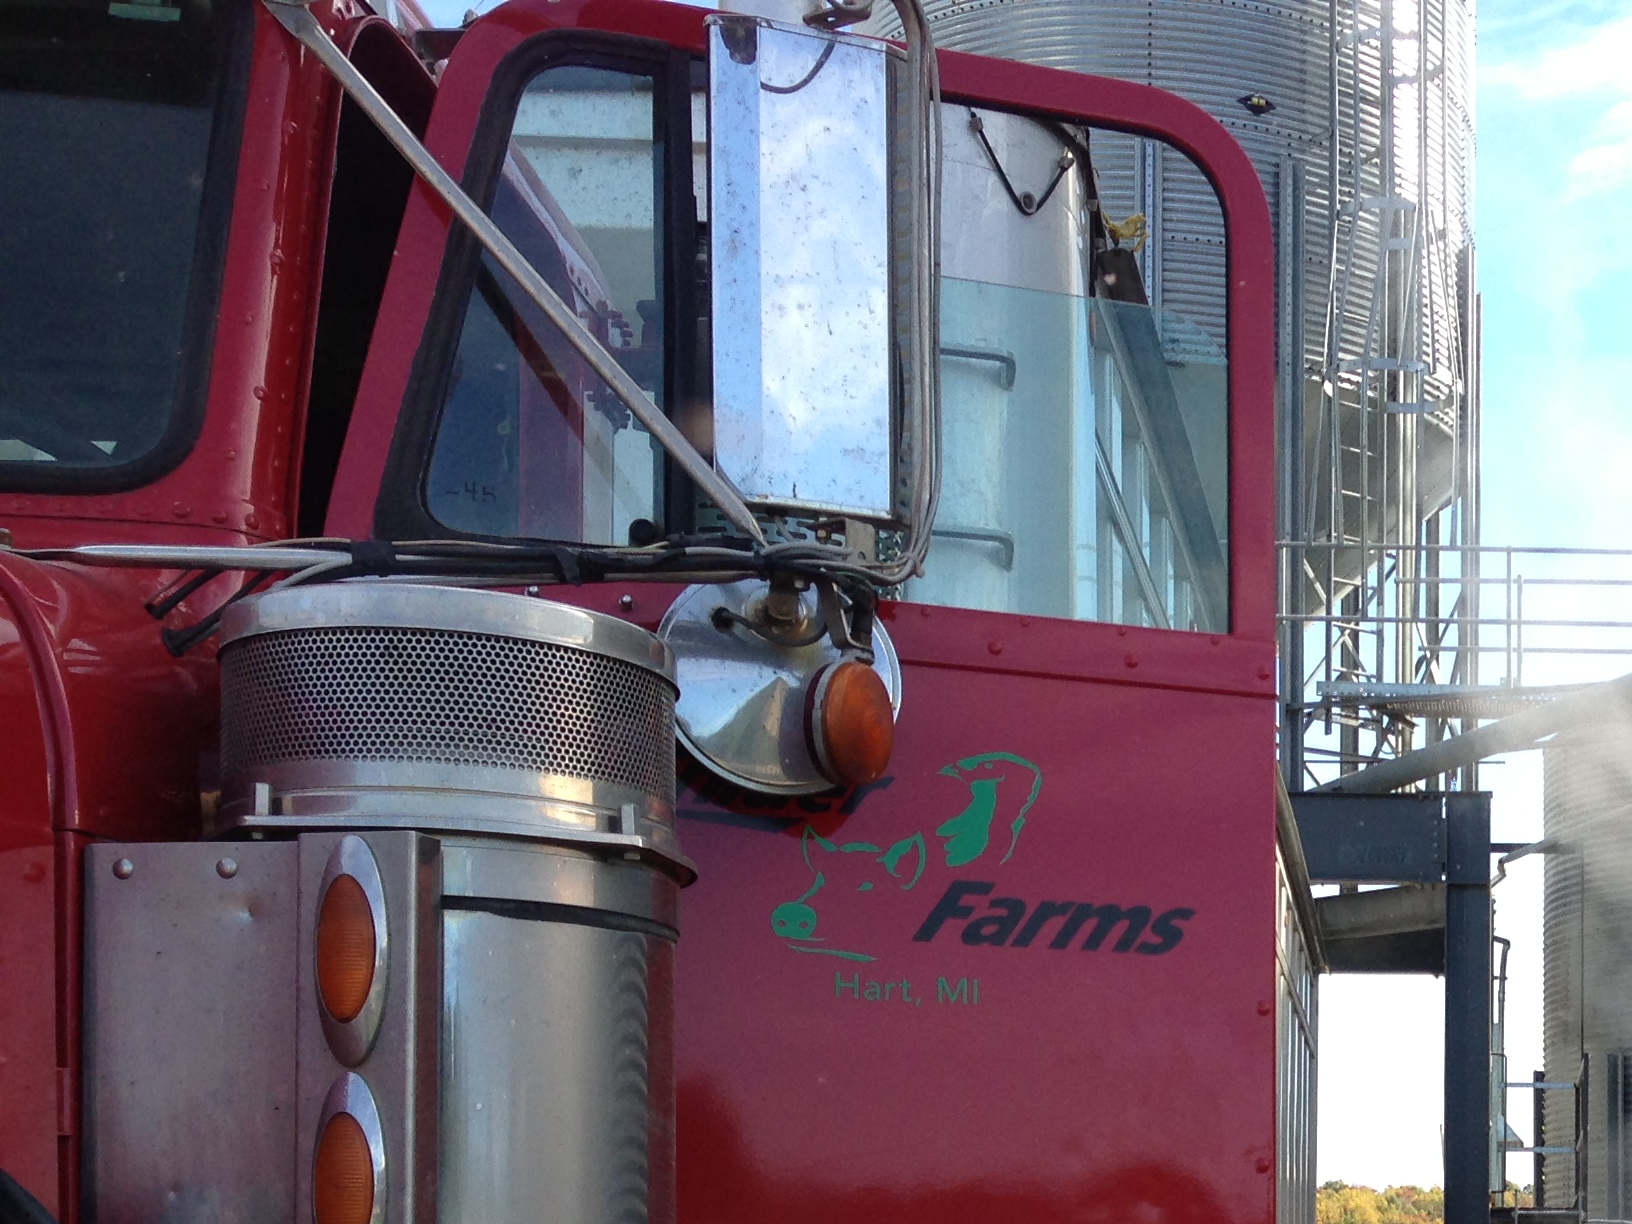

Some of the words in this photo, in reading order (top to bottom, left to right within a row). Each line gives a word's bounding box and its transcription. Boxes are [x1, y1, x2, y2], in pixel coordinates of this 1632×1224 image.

[911, 879, 1196, 956] Farms
[834, 971, 923, 1008] Hart,
[936, 975, 981, 1006] MI
